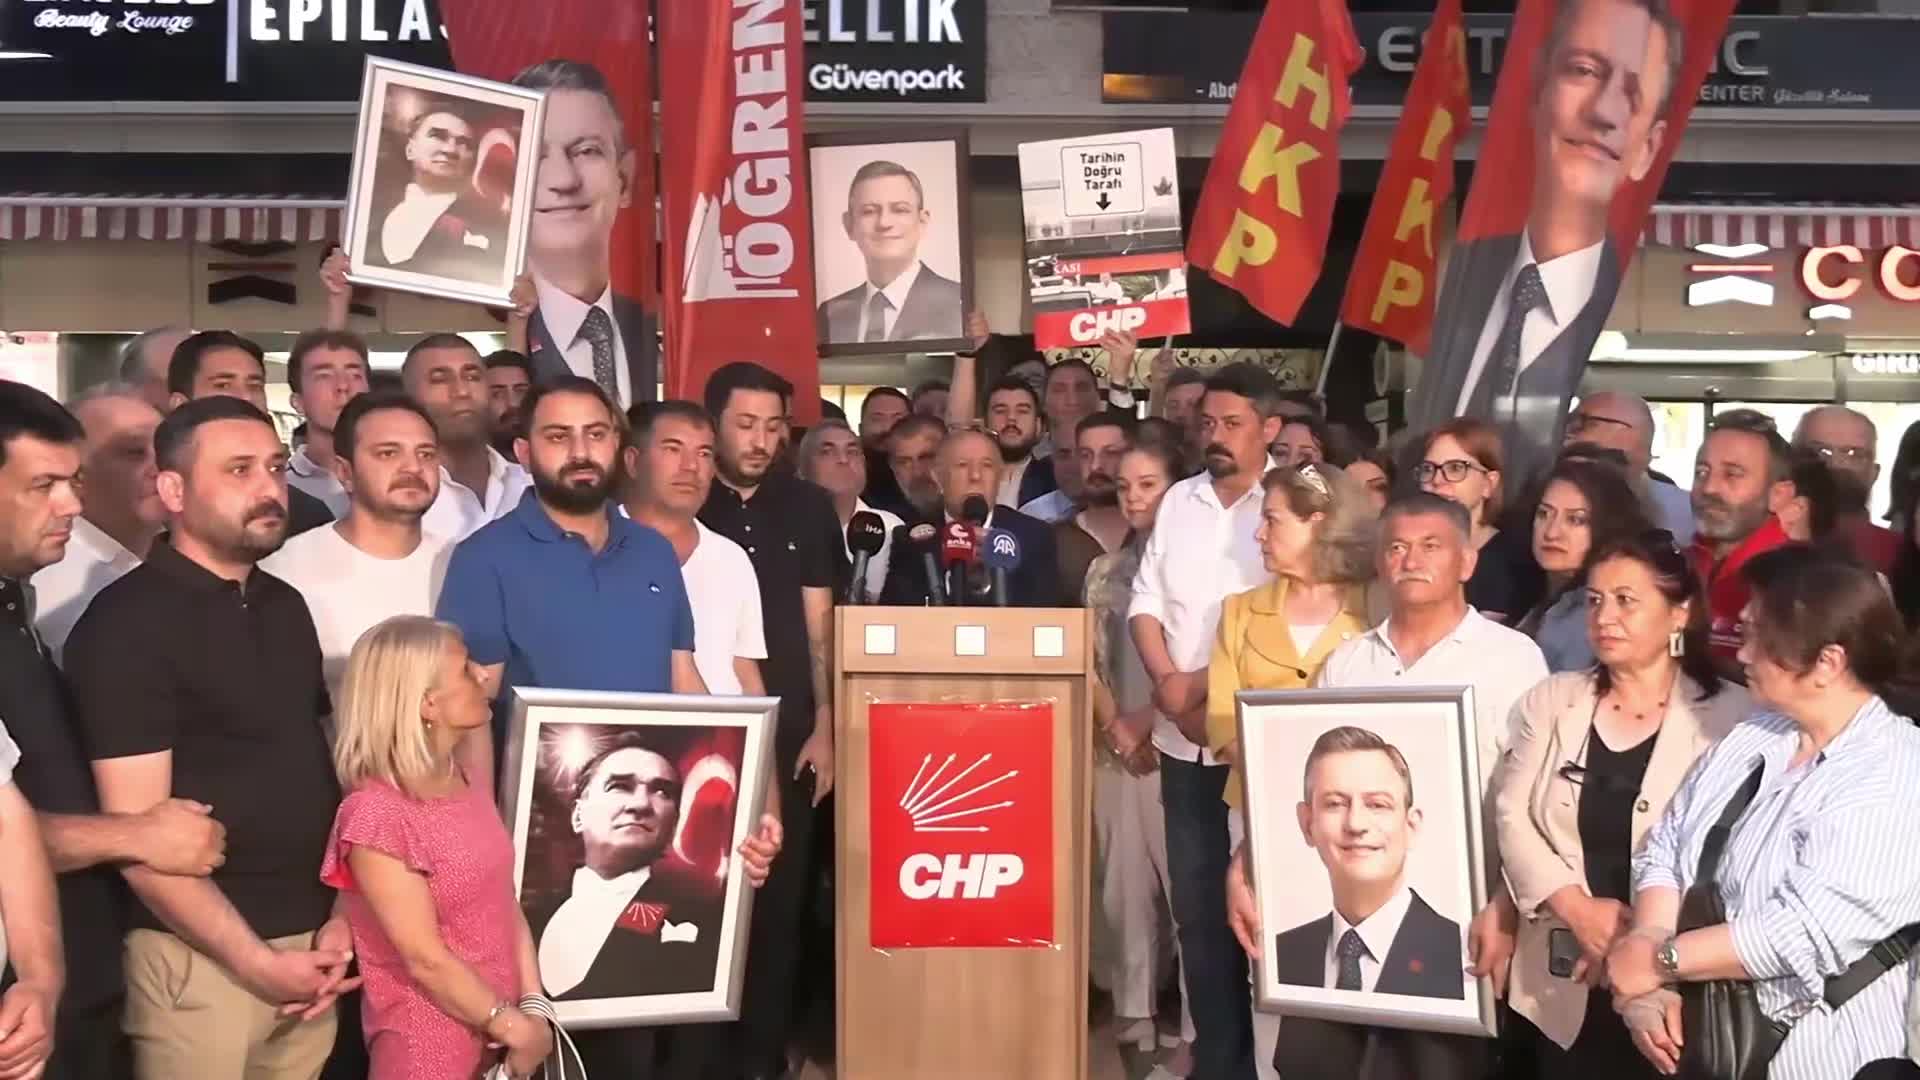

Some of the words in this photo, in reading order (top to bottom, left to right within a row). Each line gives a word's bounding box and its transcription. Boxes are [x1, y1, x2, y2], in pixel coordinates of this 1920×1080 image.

[34, 8, 110, 36] Beauty
[116, 10, 194, 35] Lounge
[250, 0, 448, 41] EPILA
[808, 63, 965, 96] Güvenpark
[1080, 152, 1125, 164] Tarihin
[1084, 165, 1122, 178] Doğru
[1070, 307, 1147, 342] CHP
[899, 853, 1024, 900] CHP
